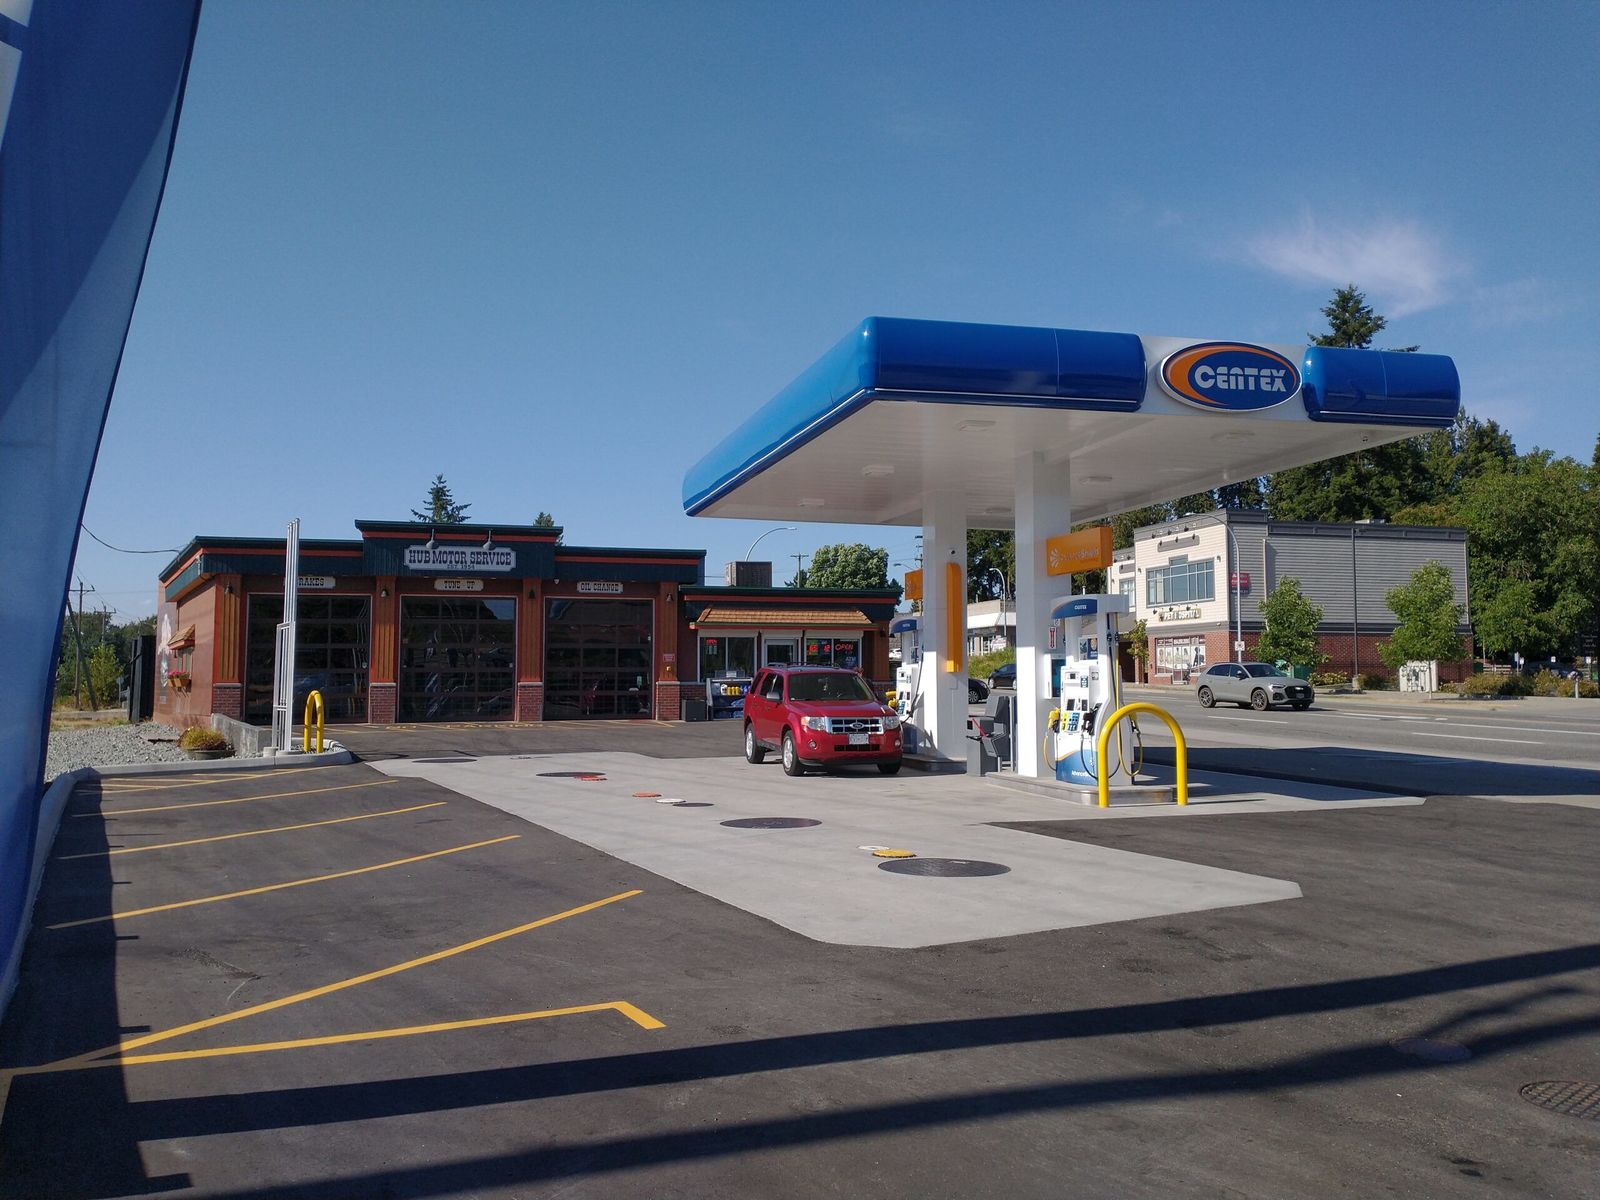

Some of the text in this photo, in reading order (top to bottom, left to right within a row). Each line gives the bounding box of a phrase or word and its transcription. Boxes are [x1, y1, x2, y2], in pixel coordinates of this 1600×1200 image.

[1194, 365, 1287, 392] CENTEX
[408, 550, 512, 566] HUB MOTOR SERVICE
[299, 577, 325, 586] RAKES
[444, 580, 461, 589] TUNE
[581, 582, 619, 592] OIL CHANGE
[1164, 611, 1174, 620] PET
[835, 643, 854, 652] OPEN
